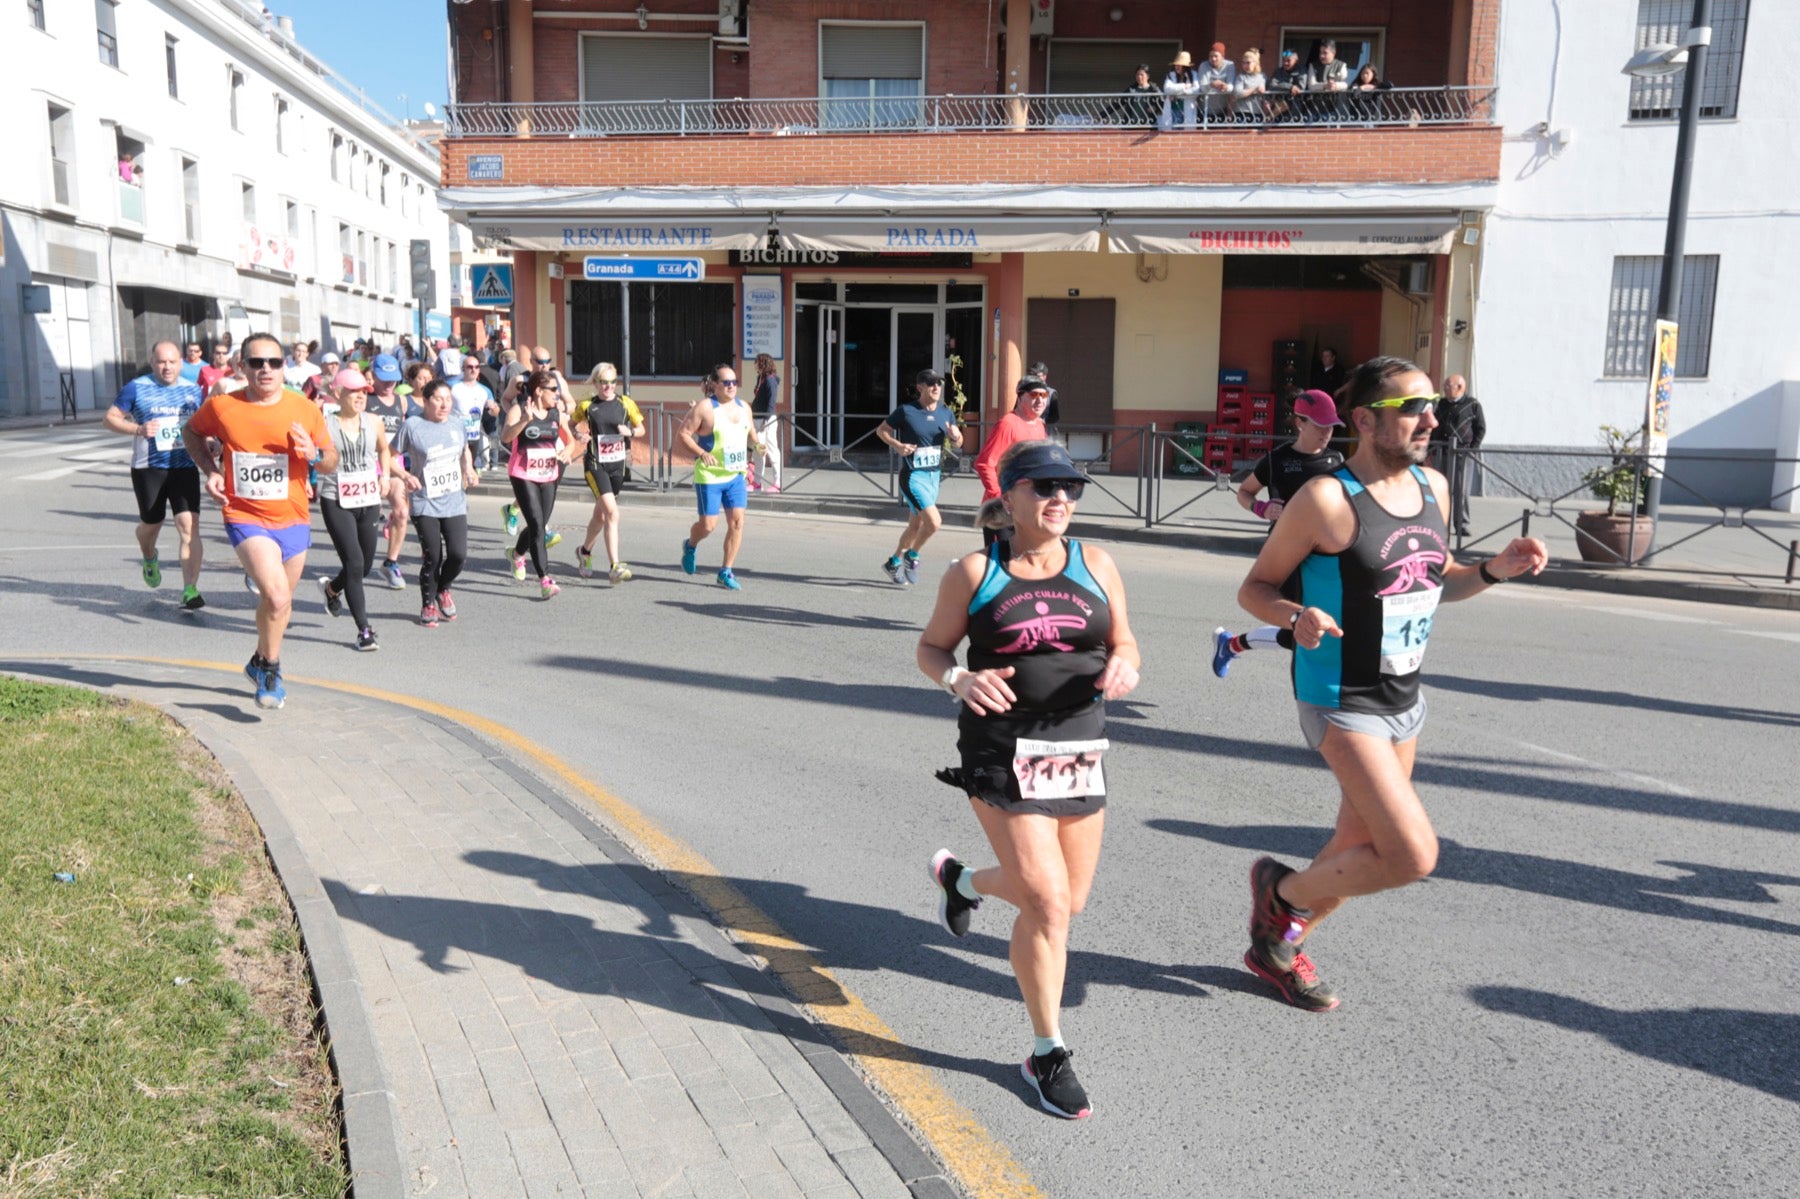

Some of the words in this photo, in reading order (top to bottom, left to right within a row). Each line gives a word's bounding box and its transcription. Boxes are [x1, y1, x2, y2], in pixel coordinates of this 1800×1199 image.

[562, 227, 712, 246] RESTAURANTE
[887, 227, 979, 246] PARADA
[587, 263, 634, 274] Granada
[659, 264, 681, 273] A-44
[240, 467, 283, 483] 3068
[430, 471, 459, 487] 3078
[341, 481, 377, 497] 2213
